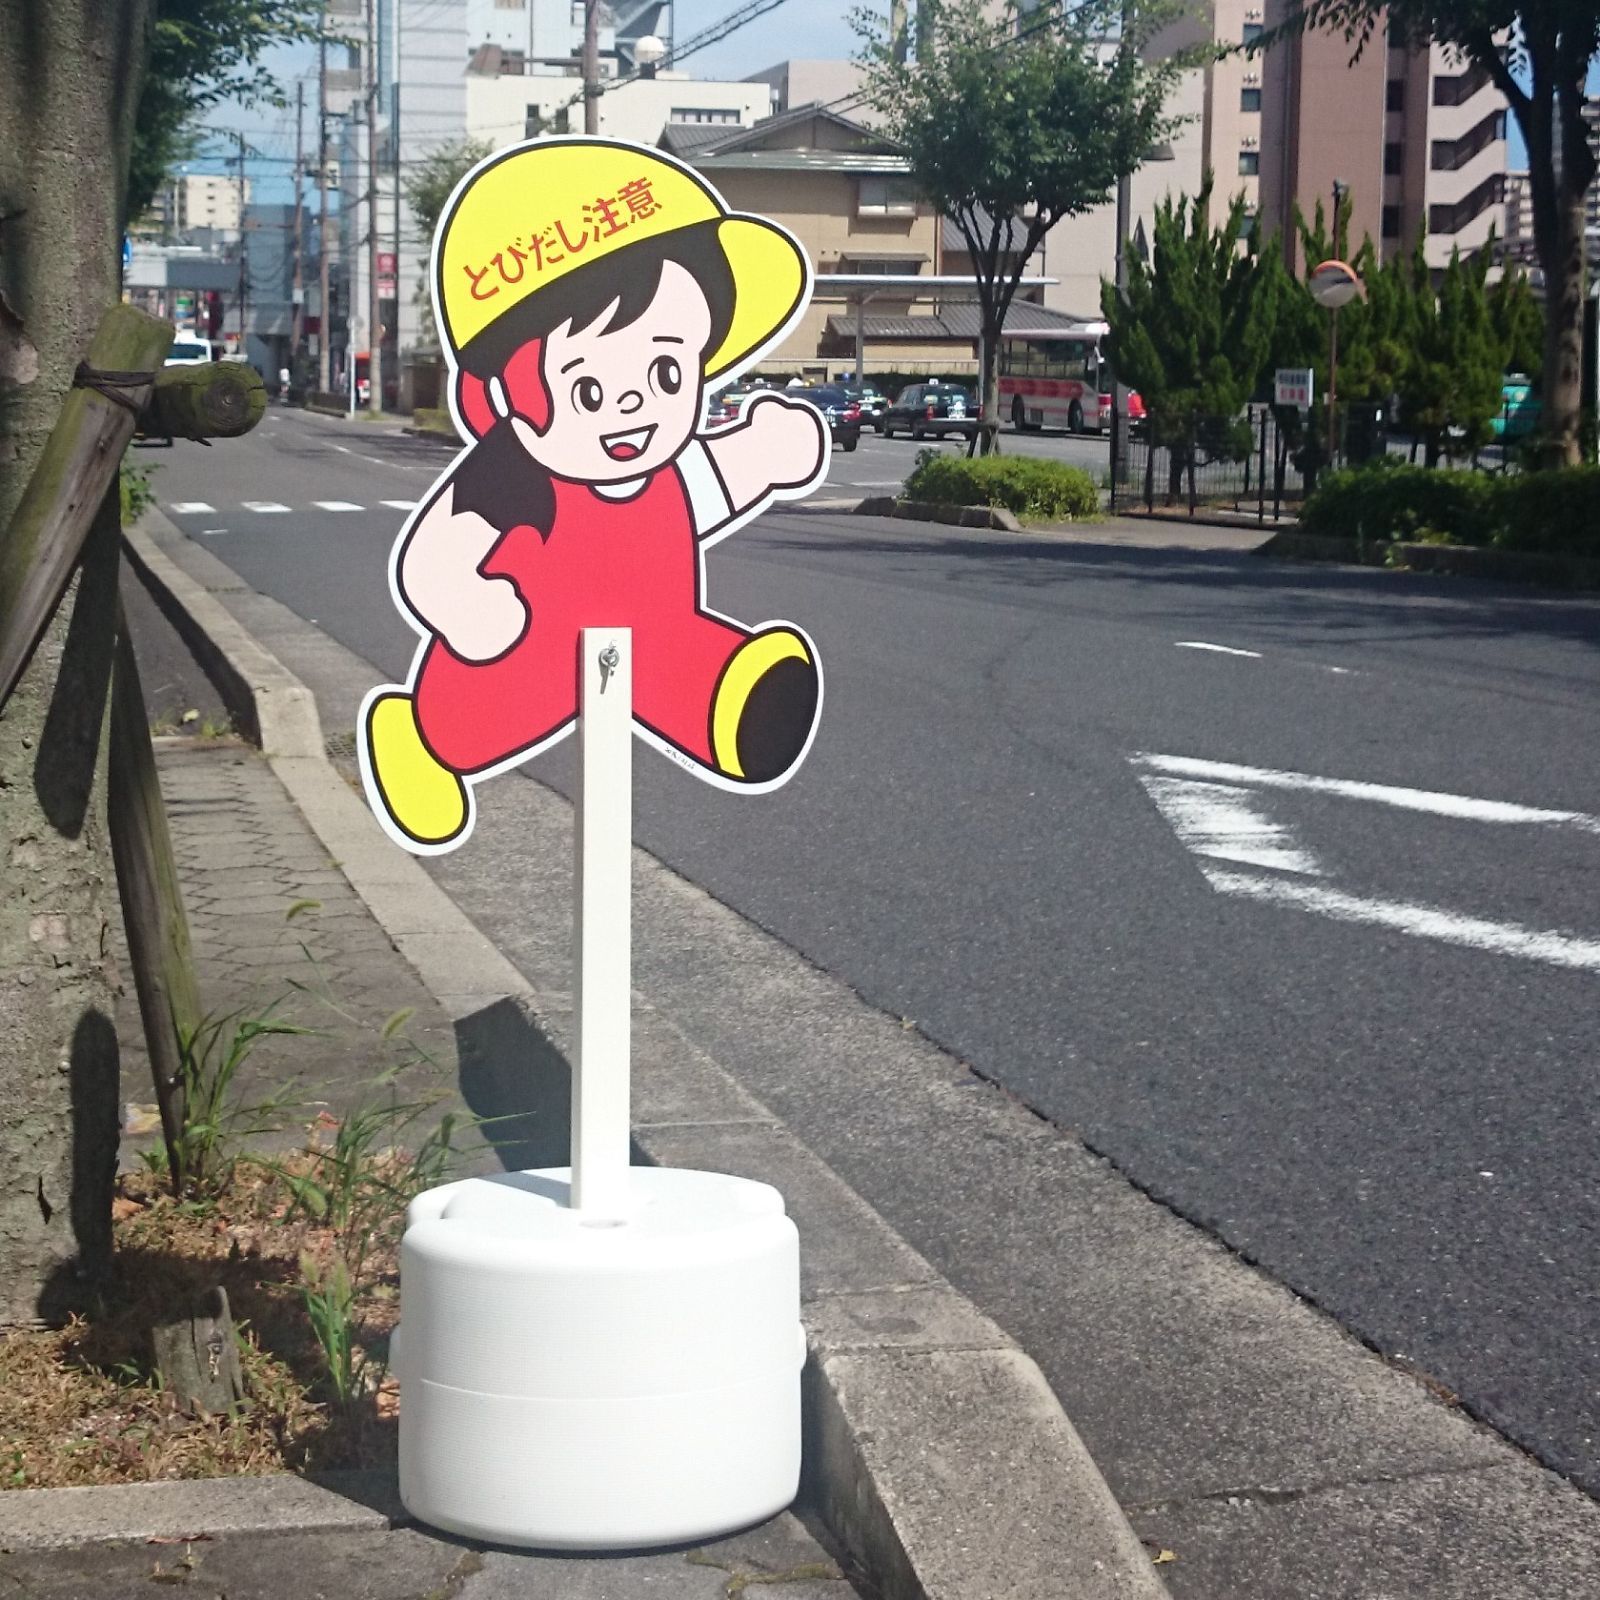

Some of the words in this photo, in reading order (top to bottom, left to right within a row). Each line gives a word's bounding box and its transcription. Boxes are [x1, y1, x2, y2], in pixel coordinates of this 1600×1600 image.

[463, 177, 662, 300] とびだし注意
